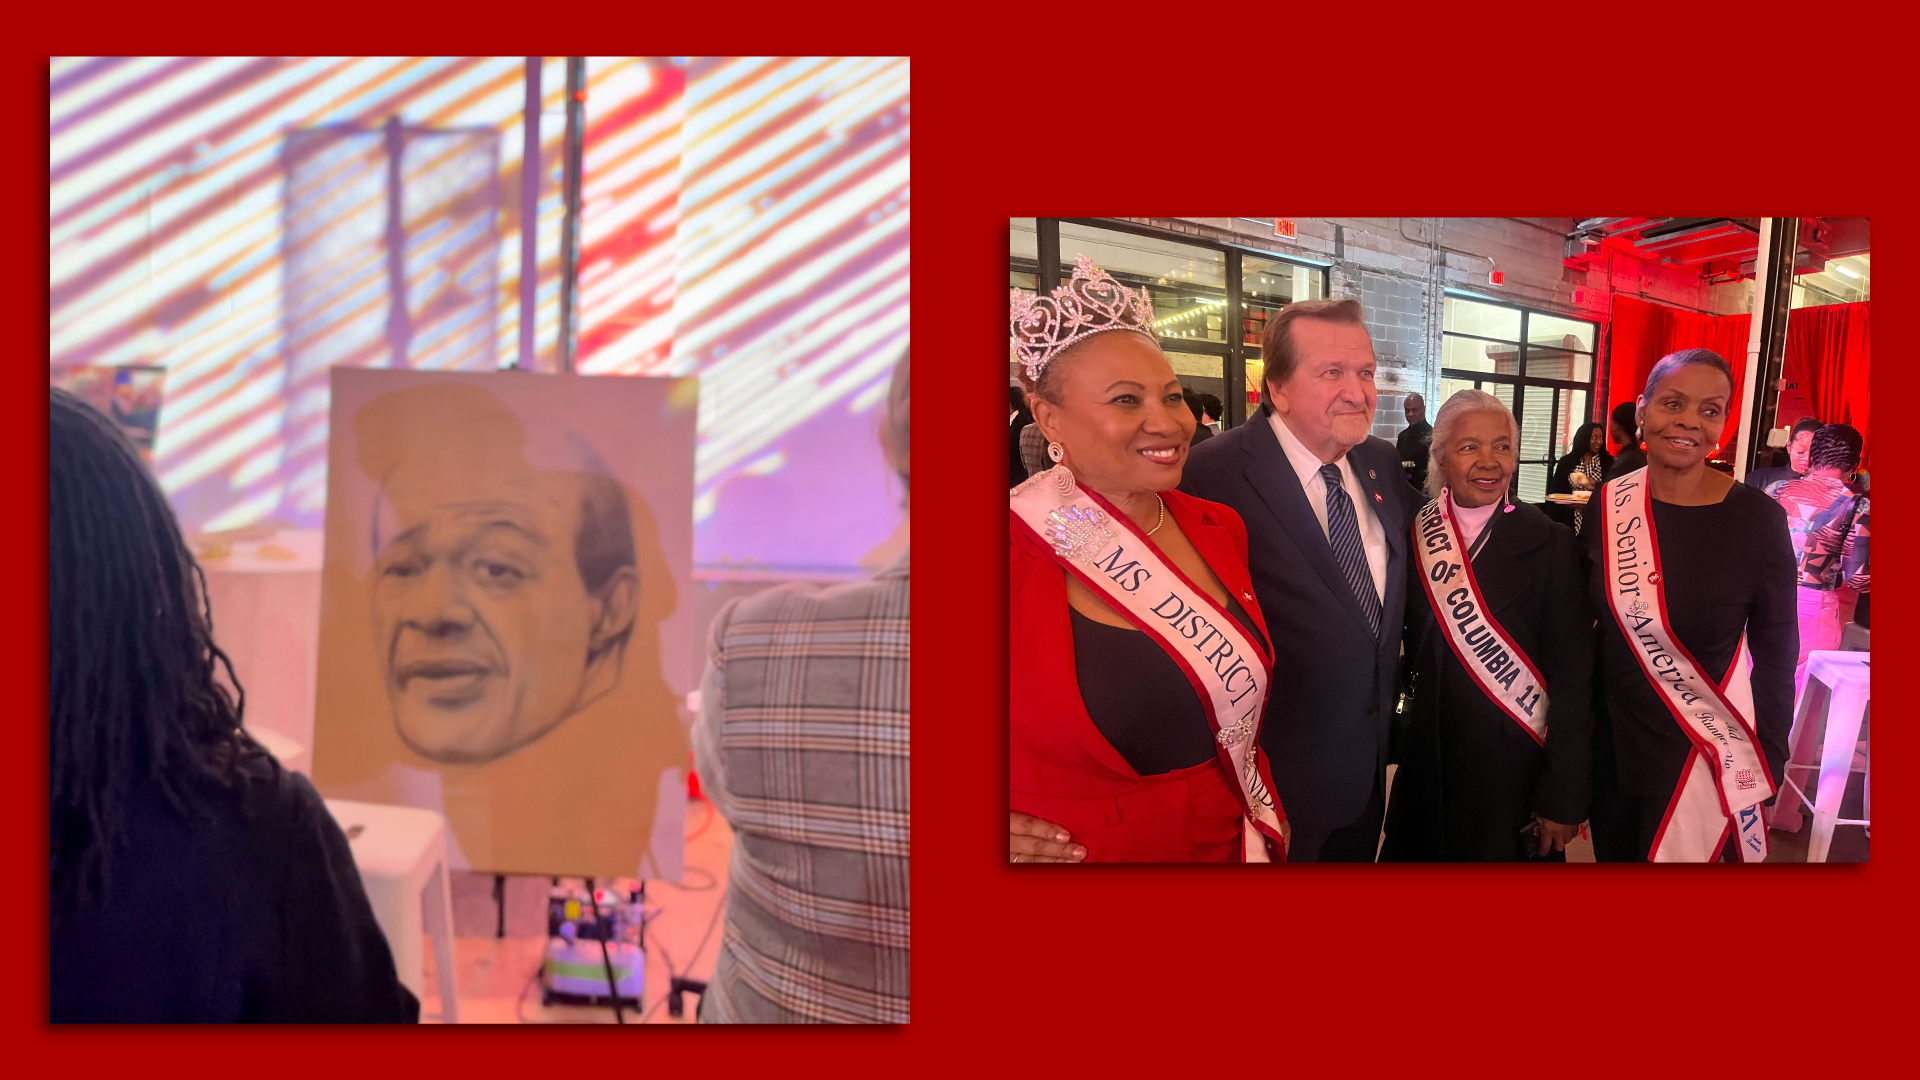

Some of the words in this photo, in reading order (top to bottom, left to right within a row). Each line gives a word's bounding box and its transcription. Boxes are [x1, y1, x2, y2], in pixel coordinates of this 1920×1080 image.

[1615, 470, 1642, 514] Ms.
[1616, 516, 1648, 597] Senior
[1092, 545, 1153, 596] MS.
[1149, 591, 1258, 707] DISTRICT
[1430, 560, 1462, 585] OF
[1446, 587, 1521, 692] COLUMBIA
[1515, 685, 1541, 717] 11
[1625, 612, 1704, 706] America
